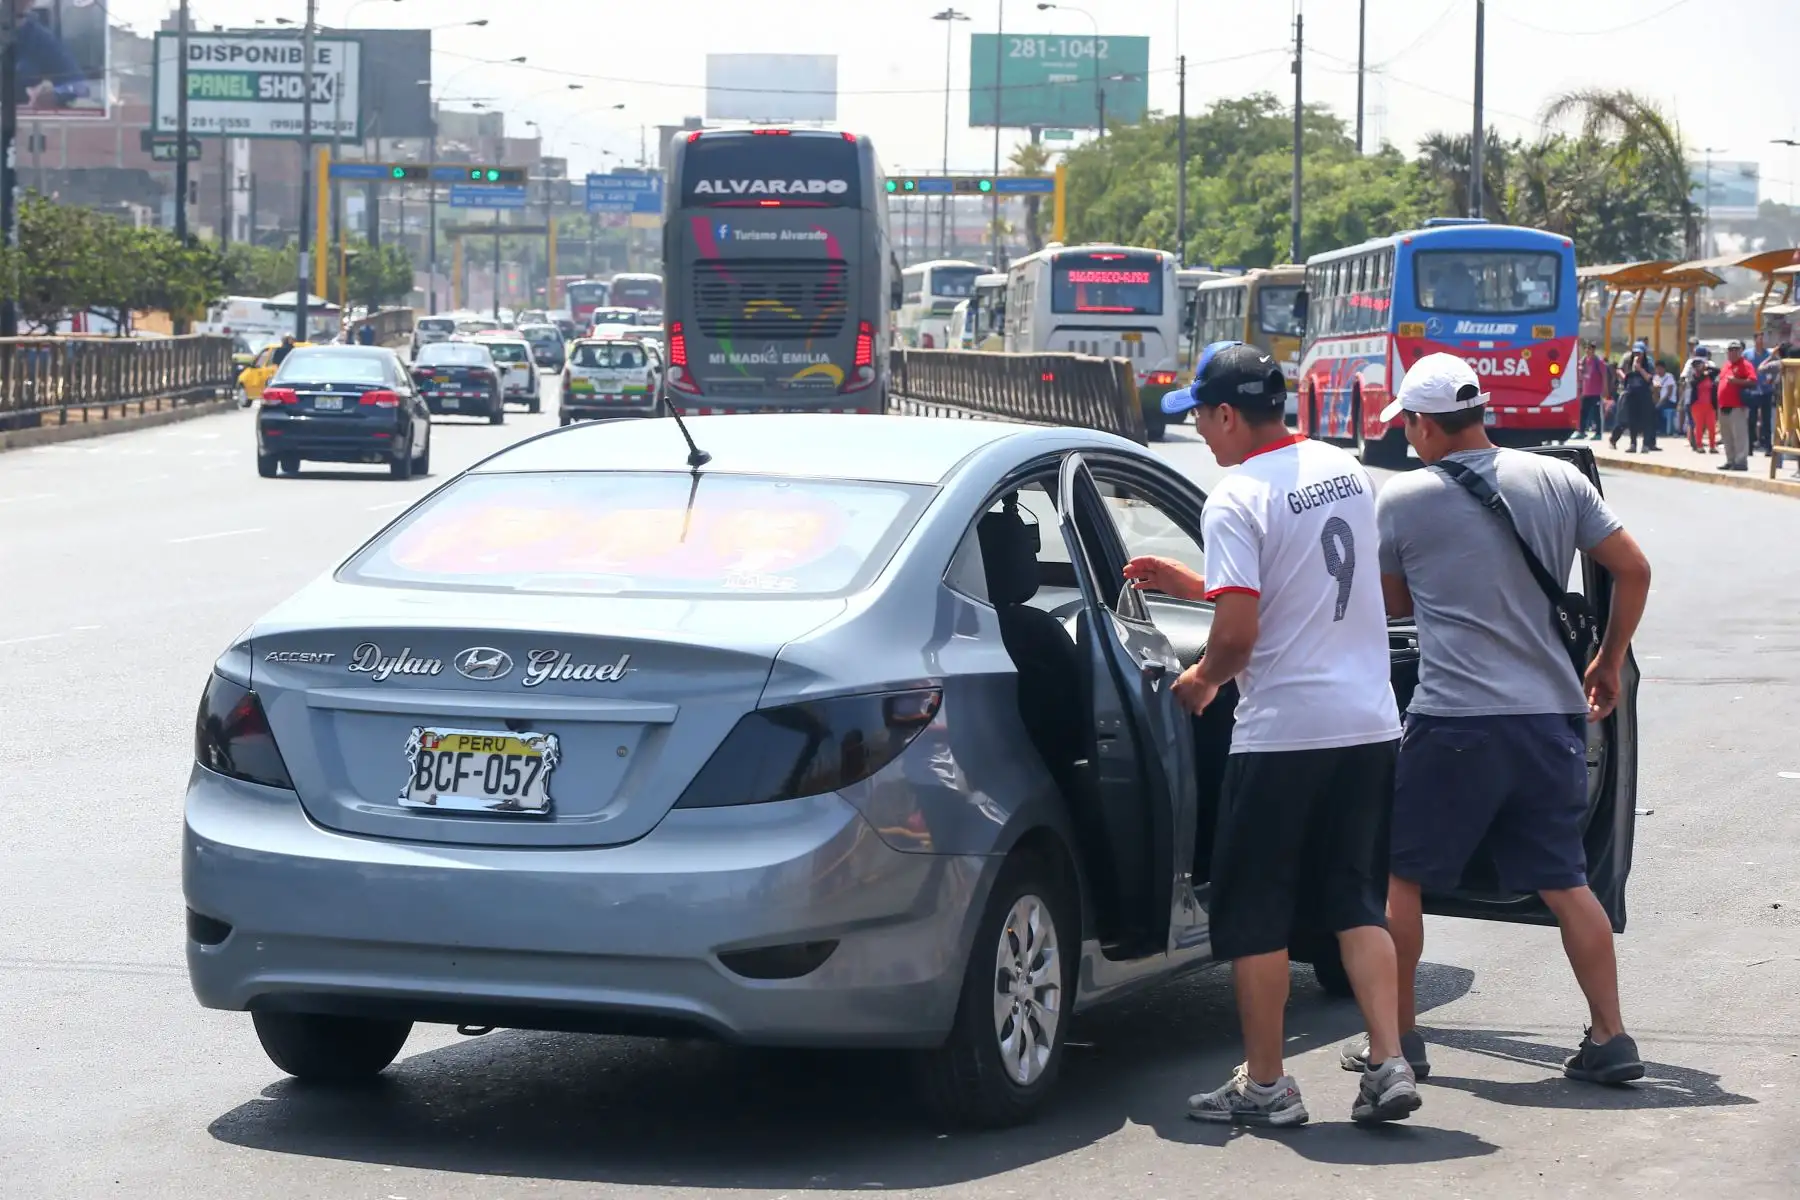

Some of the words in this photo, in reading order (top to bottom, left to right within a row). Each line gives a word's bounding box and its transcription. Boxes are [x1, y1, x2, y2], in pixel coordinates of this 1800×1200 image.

[188, 45, 332, 65] DISPONIBE
[1009, 38, 1109, 59] 281-1042
[187, 74, 253, 97] PANEL
[694, 179, 849, 194] ALVARADO
[733, 230, 778, 241] Turismo
[780, 229, 828, 241] Alvarado
[709, 353, 726, 364] MI
[782, 353, 831, 364] EMILIA
[1287, 473, 1364, 515] GUERRERO
[1320, 516, 1356, 622] 9
[265, 651, 335, 664] ACCENT
[348, 642, 444, 682] Dylan
[522, 648, 631, 688] Ghael
[458, 735, 506, 752] PERU
[415, 750, 542, 798] BCF-057
